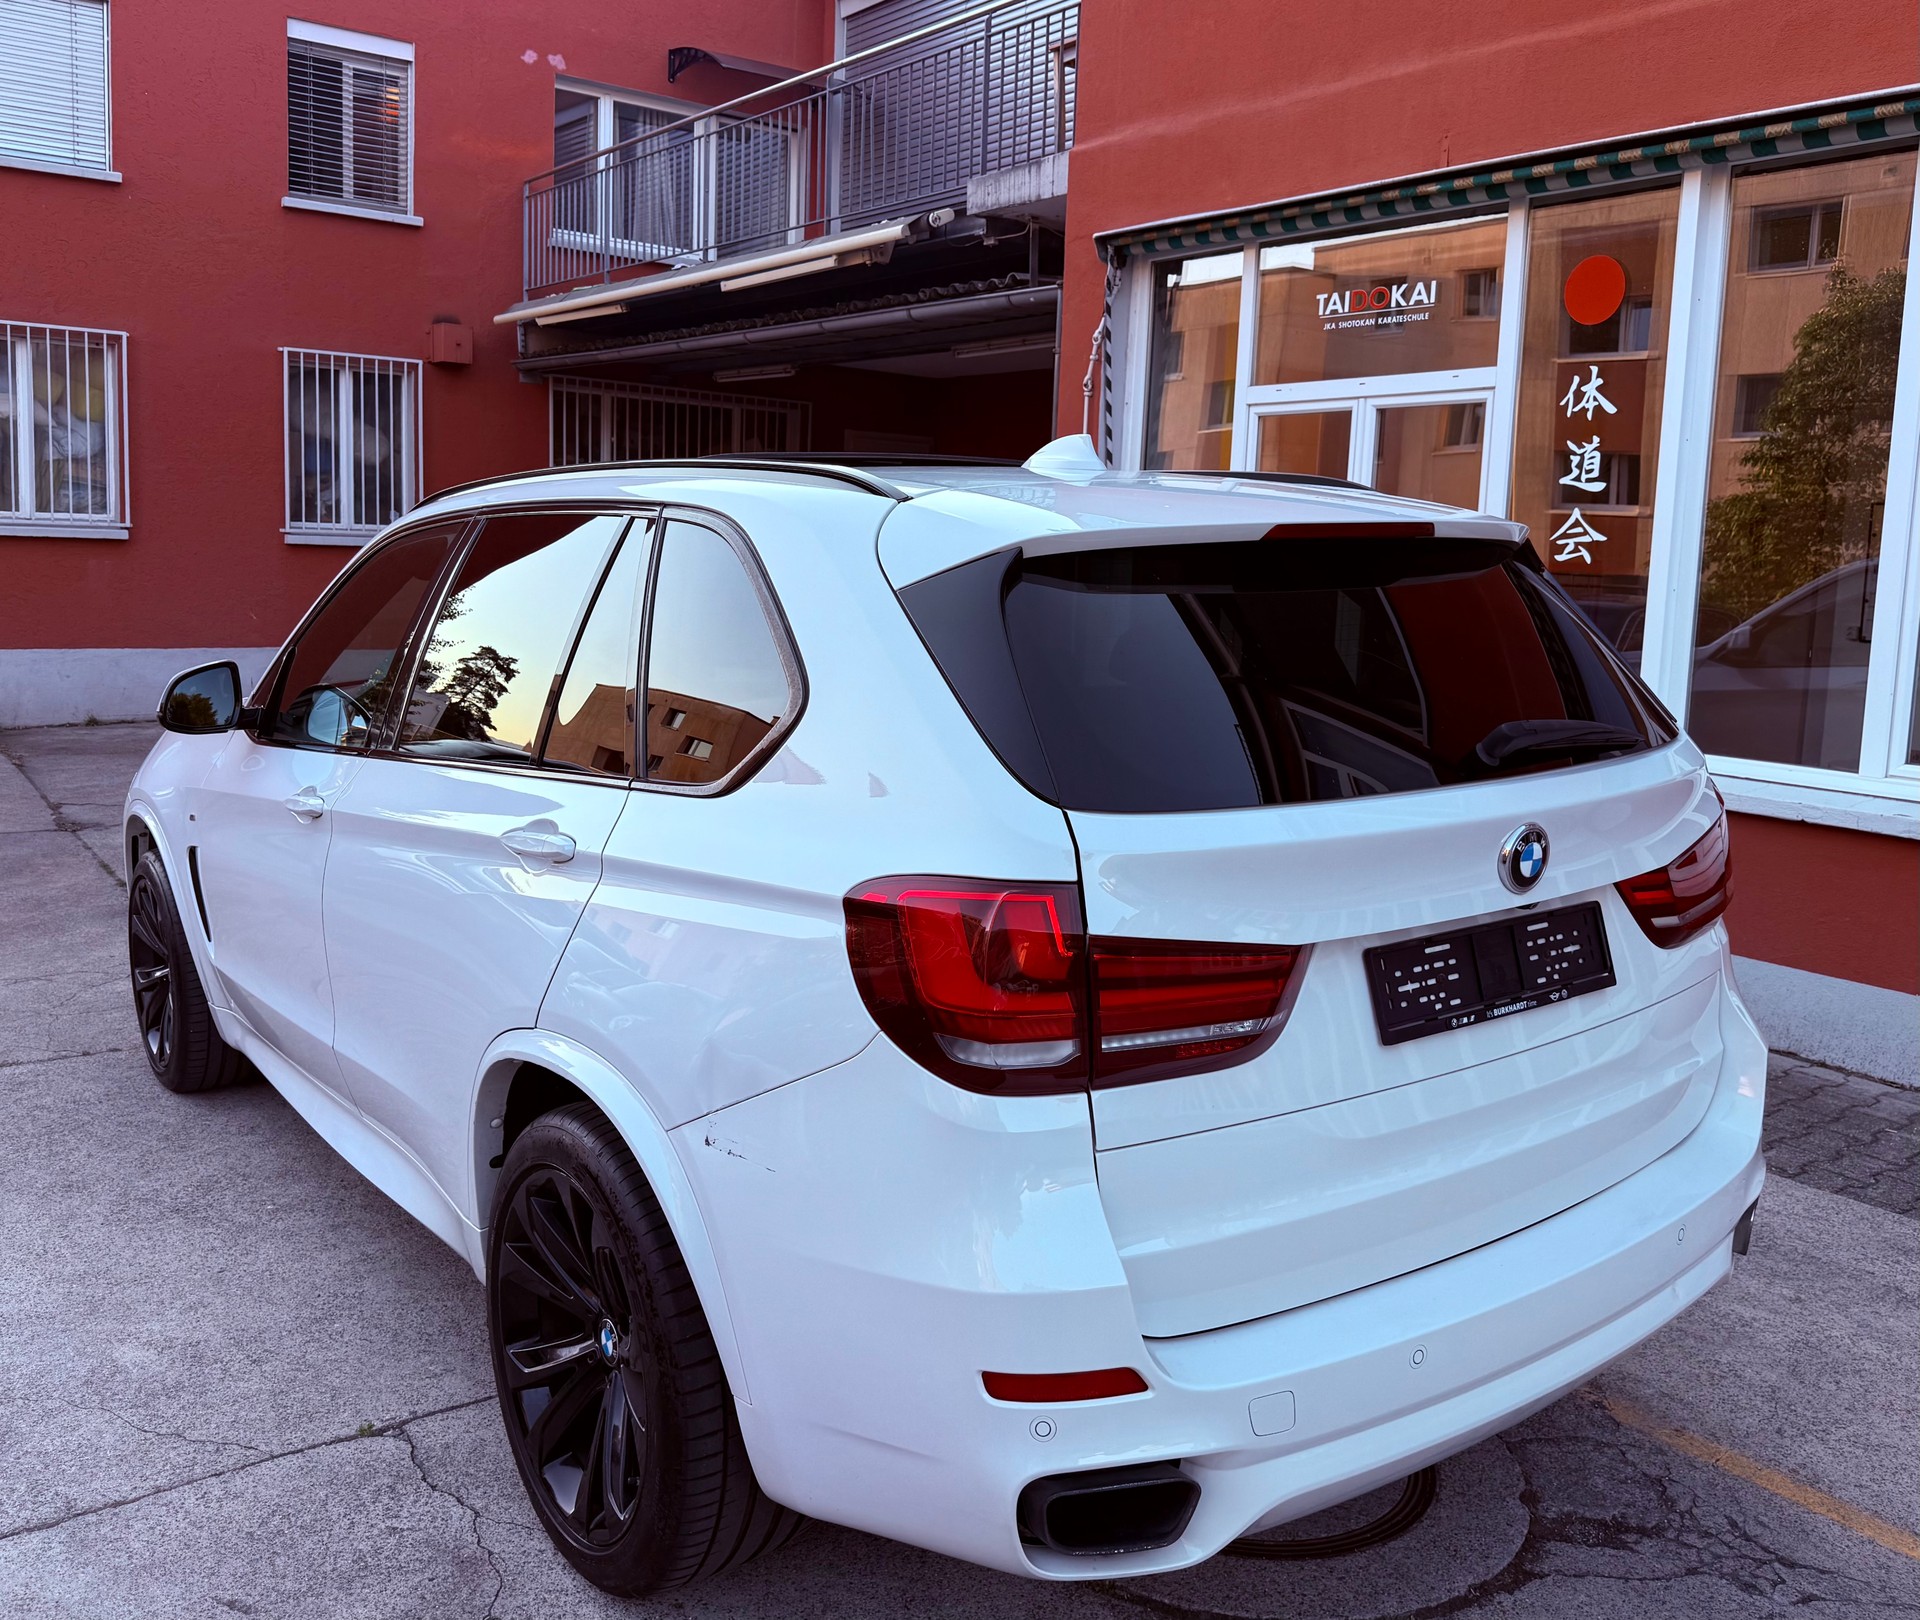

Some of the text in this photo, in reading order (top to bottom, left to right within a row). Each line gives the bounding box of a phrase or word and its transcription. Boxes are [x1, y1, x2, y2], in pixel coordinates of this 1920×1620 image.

[1316, 280, 1437, 316] TAIDOKAI
[1323, 312, 1430, 331] JKA SHOTOKAN KARATESCHULE
[1549, 365, 1618, 565] 体道会
[1516, 832, 1547, 852] BMW
[1494, 1001, 1527, 1017] BURKHARDT
